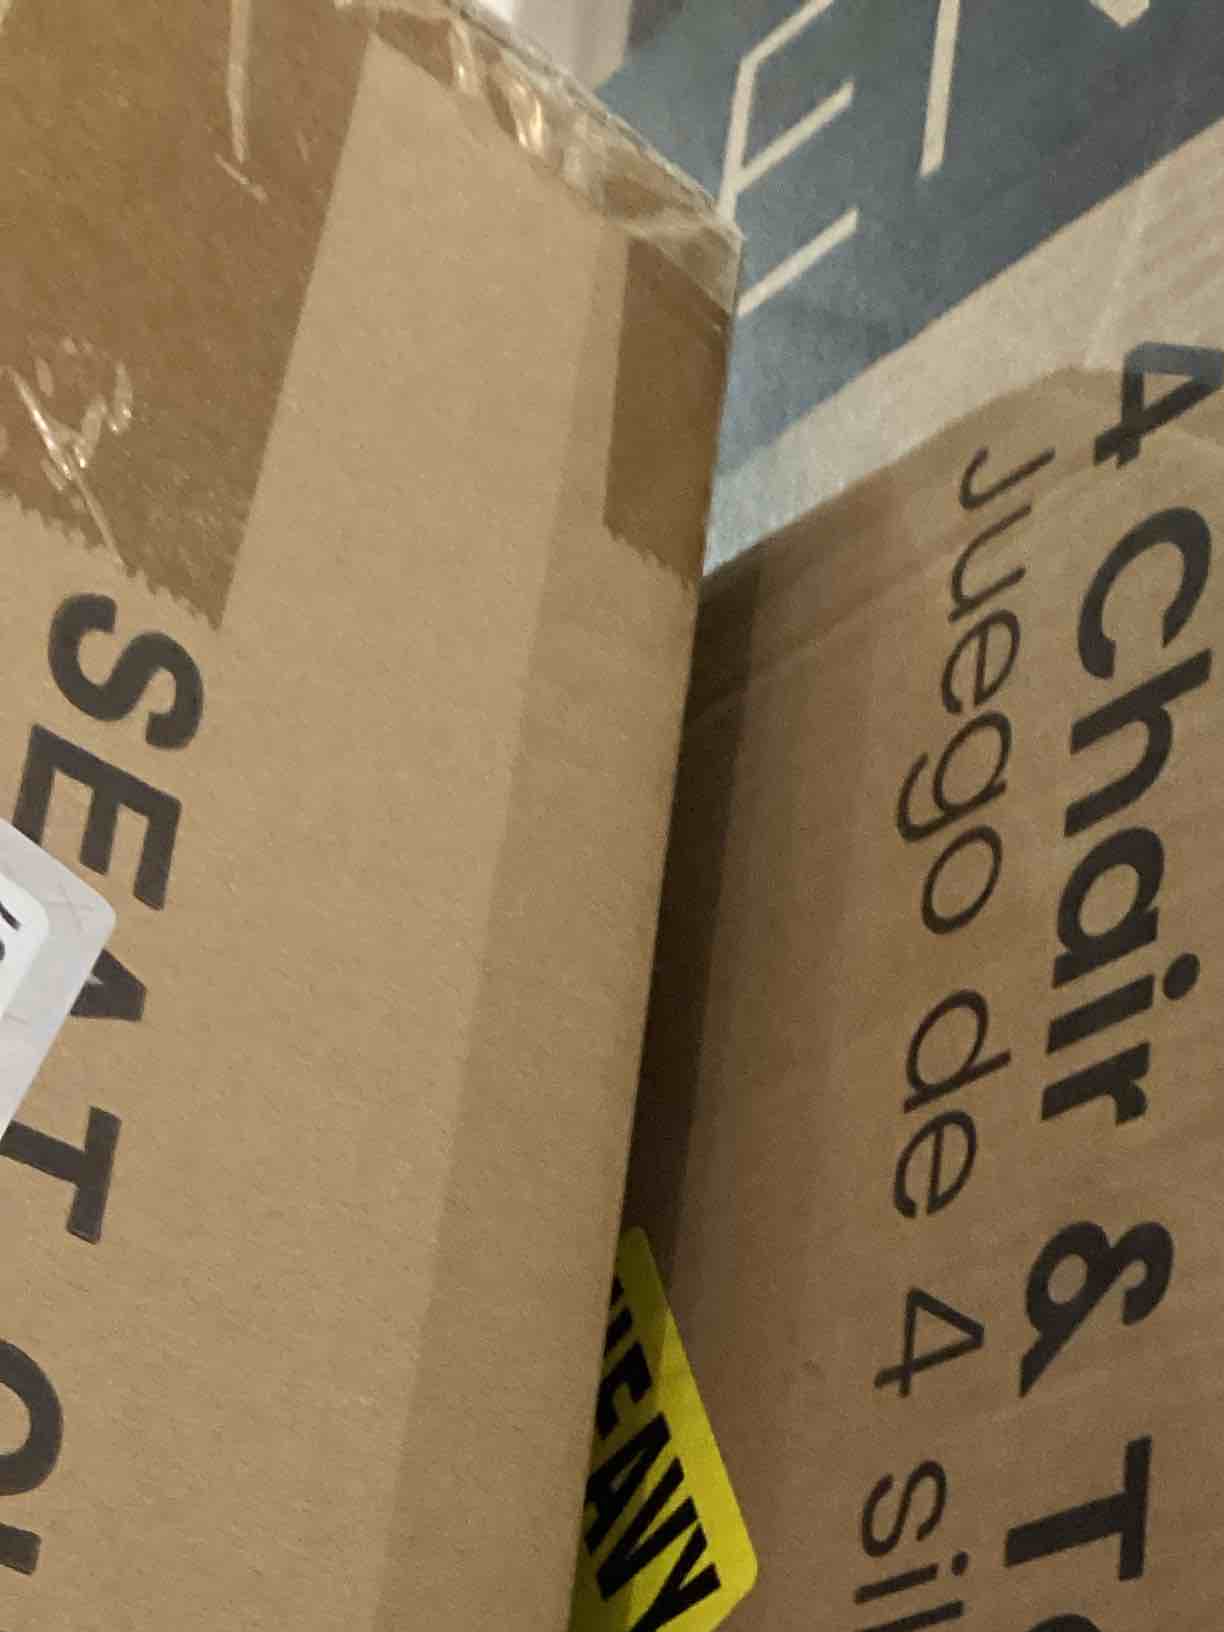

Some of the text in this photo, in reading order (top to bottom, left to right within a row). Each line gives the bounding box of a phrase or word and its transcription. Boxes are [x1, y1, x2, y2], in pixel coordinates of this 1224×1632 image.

[897, 445, 1055, 935] Juego
[1041, 505, 1213, 1124] Chair
[893, 989, 1011, 1219] de
[872, 1286, 985, 1398] 4
[1018, 1220, 1175, 1399] &
